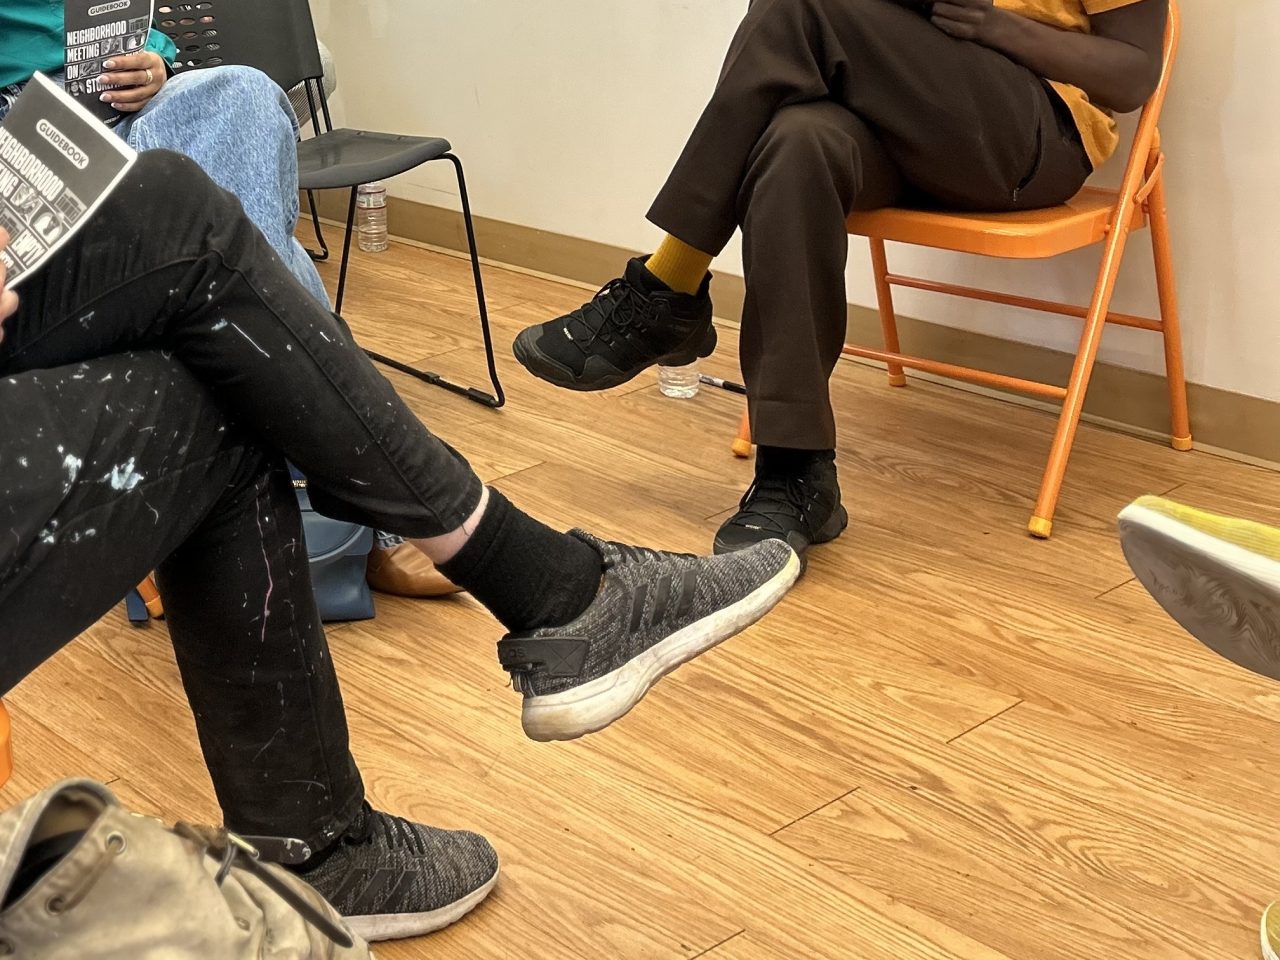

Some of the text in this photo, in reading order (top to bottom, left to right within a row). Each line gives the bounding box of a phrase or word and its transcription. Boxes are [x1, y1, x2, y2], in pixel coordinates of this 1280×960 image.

[89, 0, 129, 15] GUIDEBOOK
[66, 20, 127, 46] NEIGHBORHOOD
[66, 43, 100, 63] MEETING
[66, 65, 79, 80] ON
[38, 121, 87, 167] GUIDEBOOK
[11, 228, 46, 267] EMPTY
